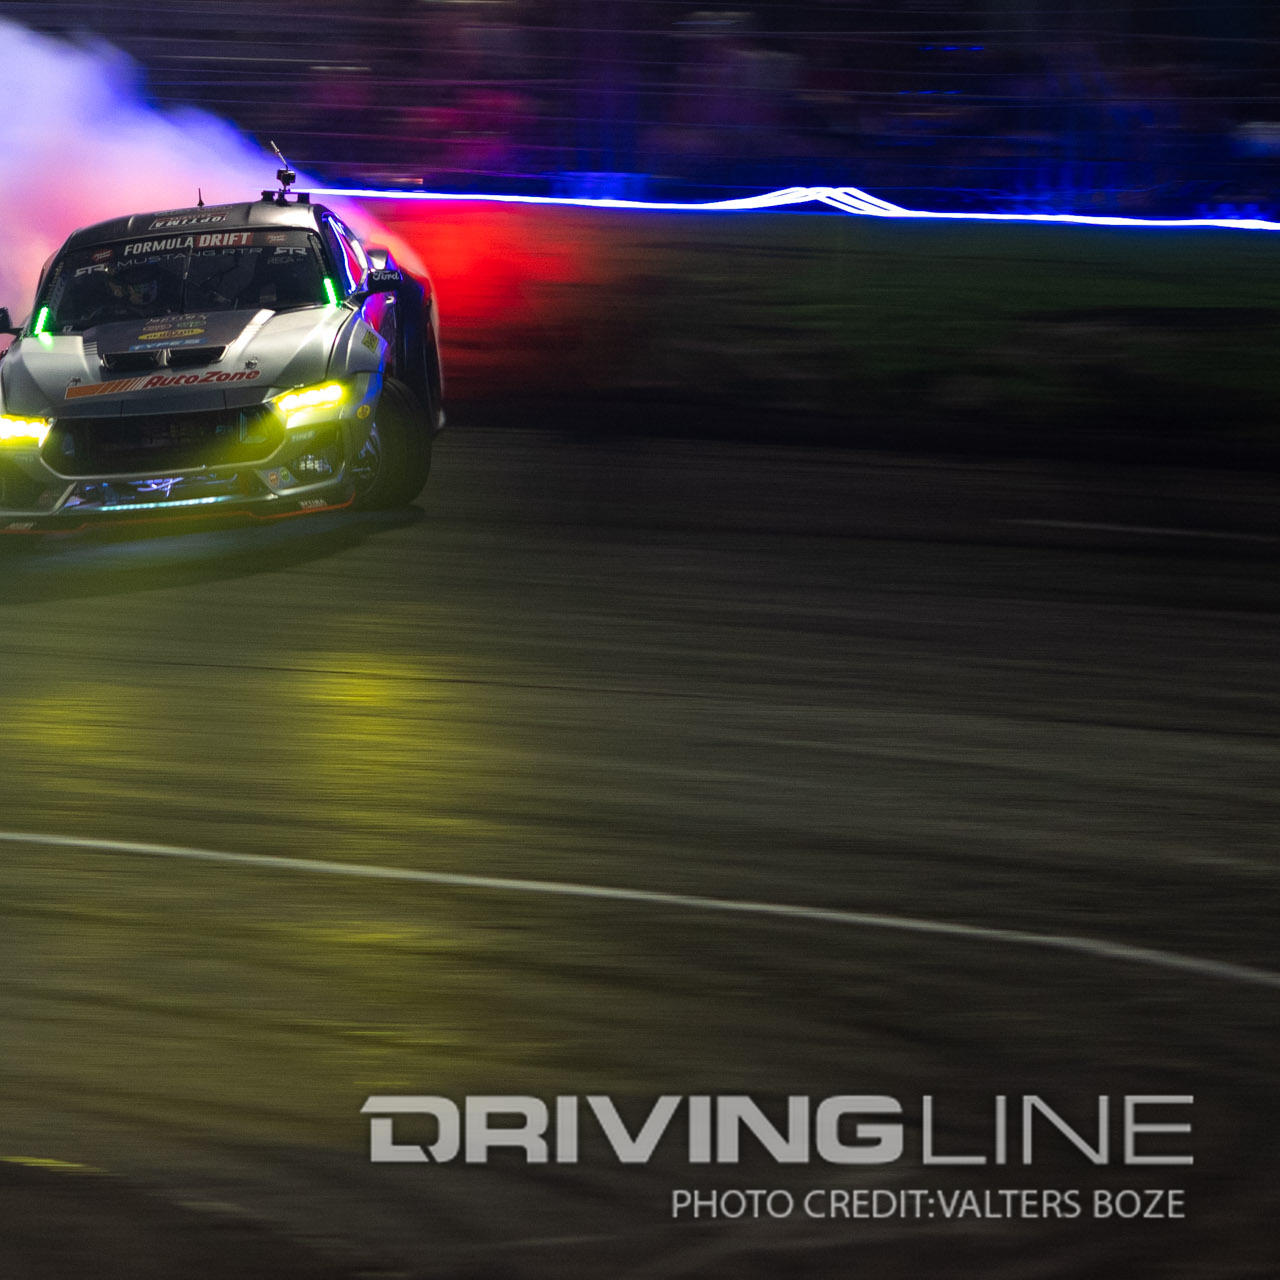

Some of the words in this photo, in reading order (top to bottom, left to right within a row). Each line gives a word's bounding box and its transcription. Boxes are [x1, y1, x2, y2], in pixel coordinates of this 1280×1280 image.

[123, 236, 194, 256] FORMULA
[198, 232, 252, 247] DRIFT
[117, 247, 216, 268] MUSTANG
[372, 271, 400, 281] Ford
[143, 370, 261, 389] AutoZone
